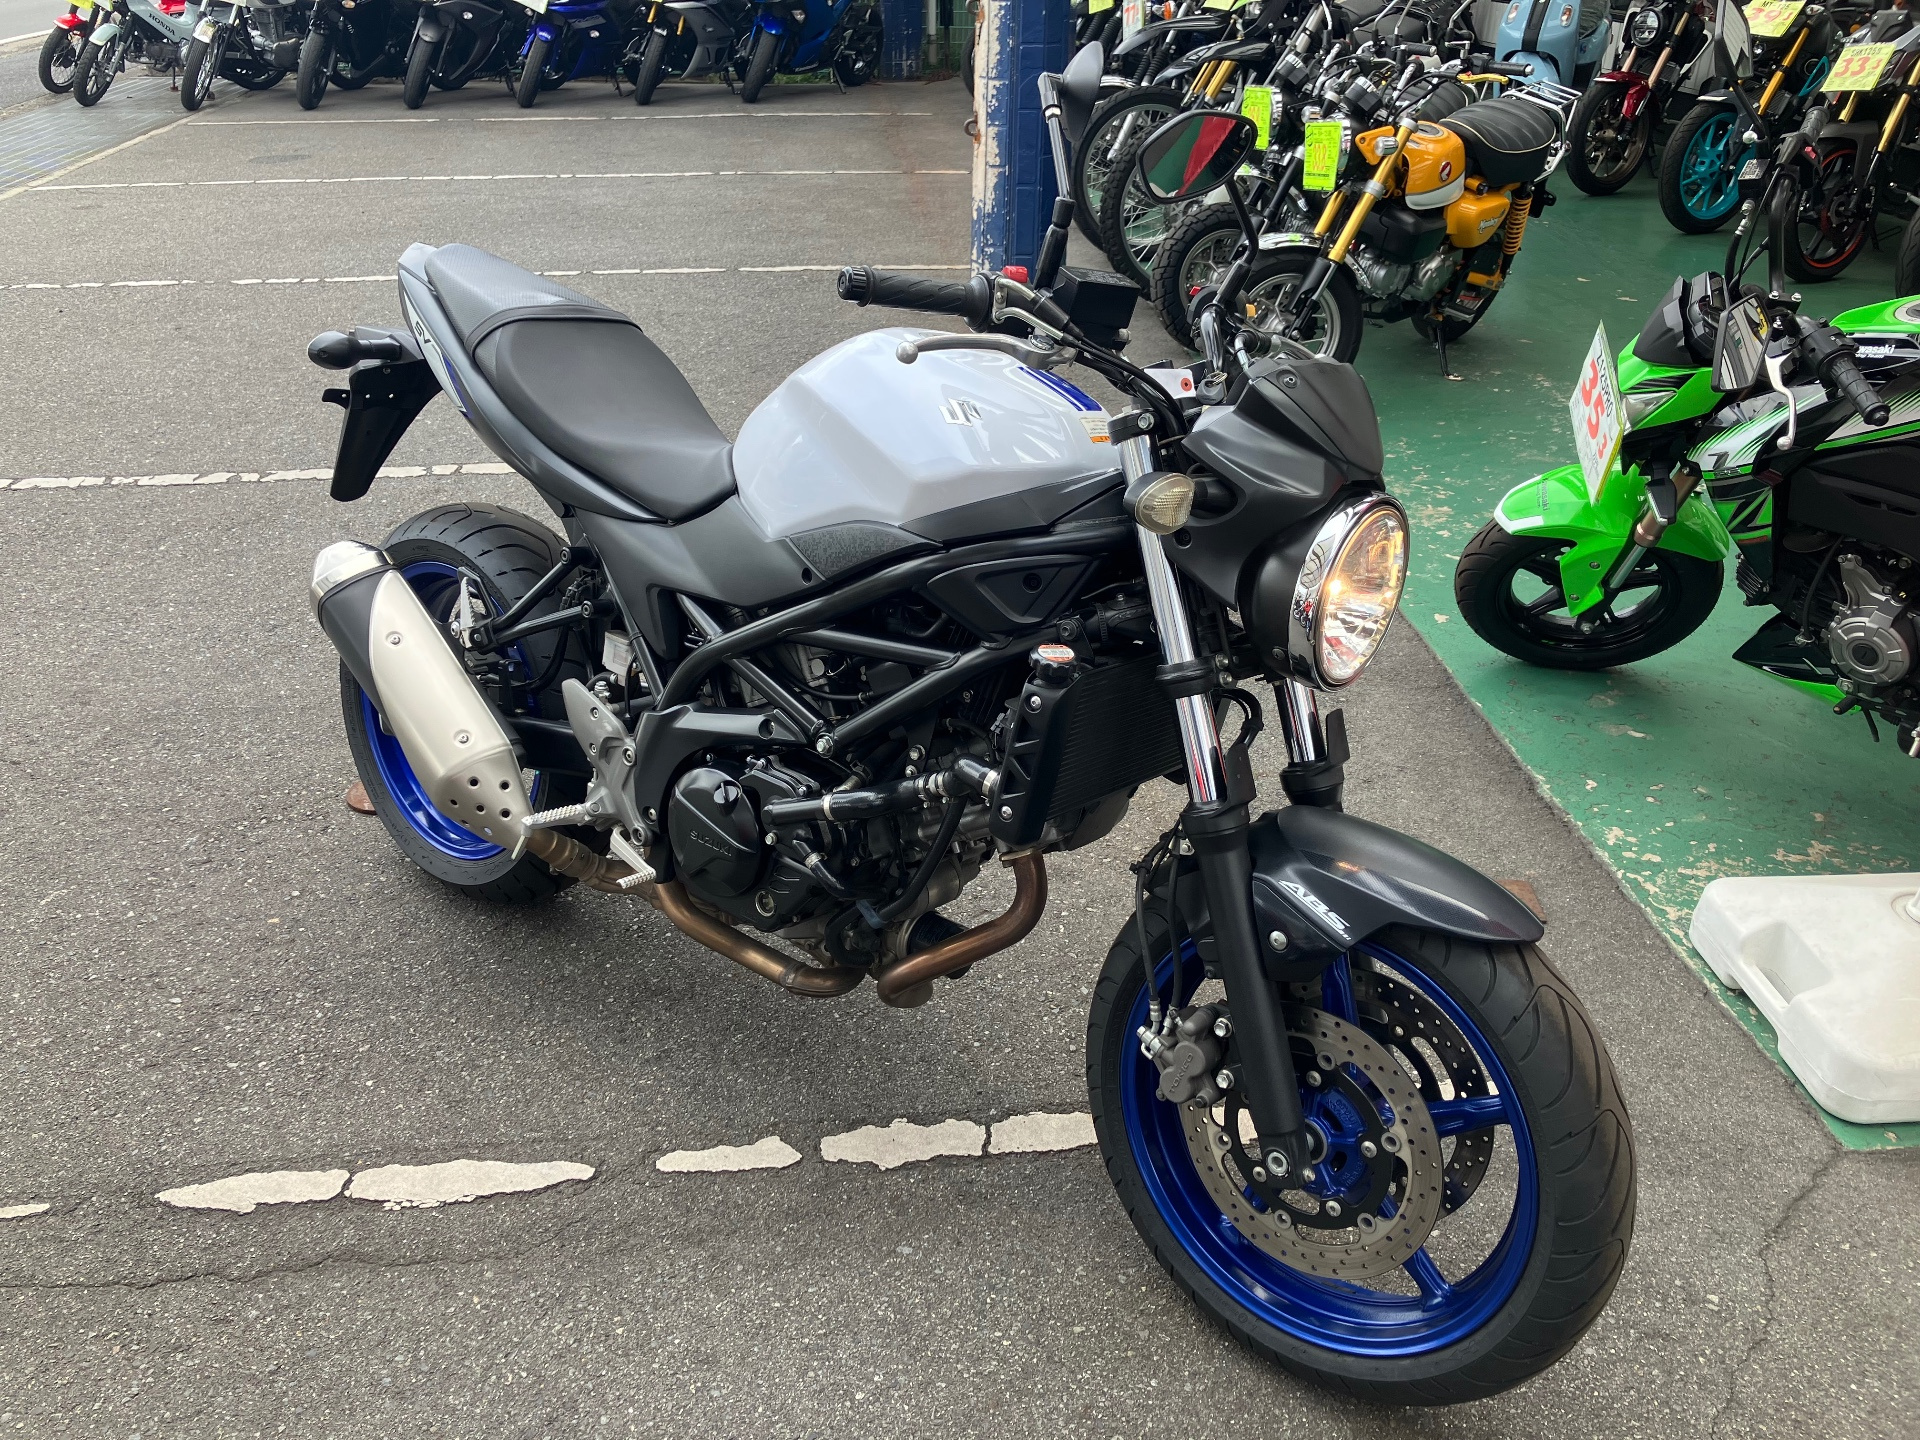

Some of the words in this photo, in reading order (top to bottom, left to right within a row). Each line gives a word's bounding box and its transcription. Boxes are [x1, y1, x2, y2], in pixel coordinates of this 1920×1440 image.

[149, 12, 175, 36] HONDA
[415, 320, 431, 344] SV
[1856, 344, 1896, 354] wasaki
[690, 830, 732, 857] SUZUKI
[1279, 880, 1351, 930] ABS
[1169, 1052, 1194, 1093] TOKICO
